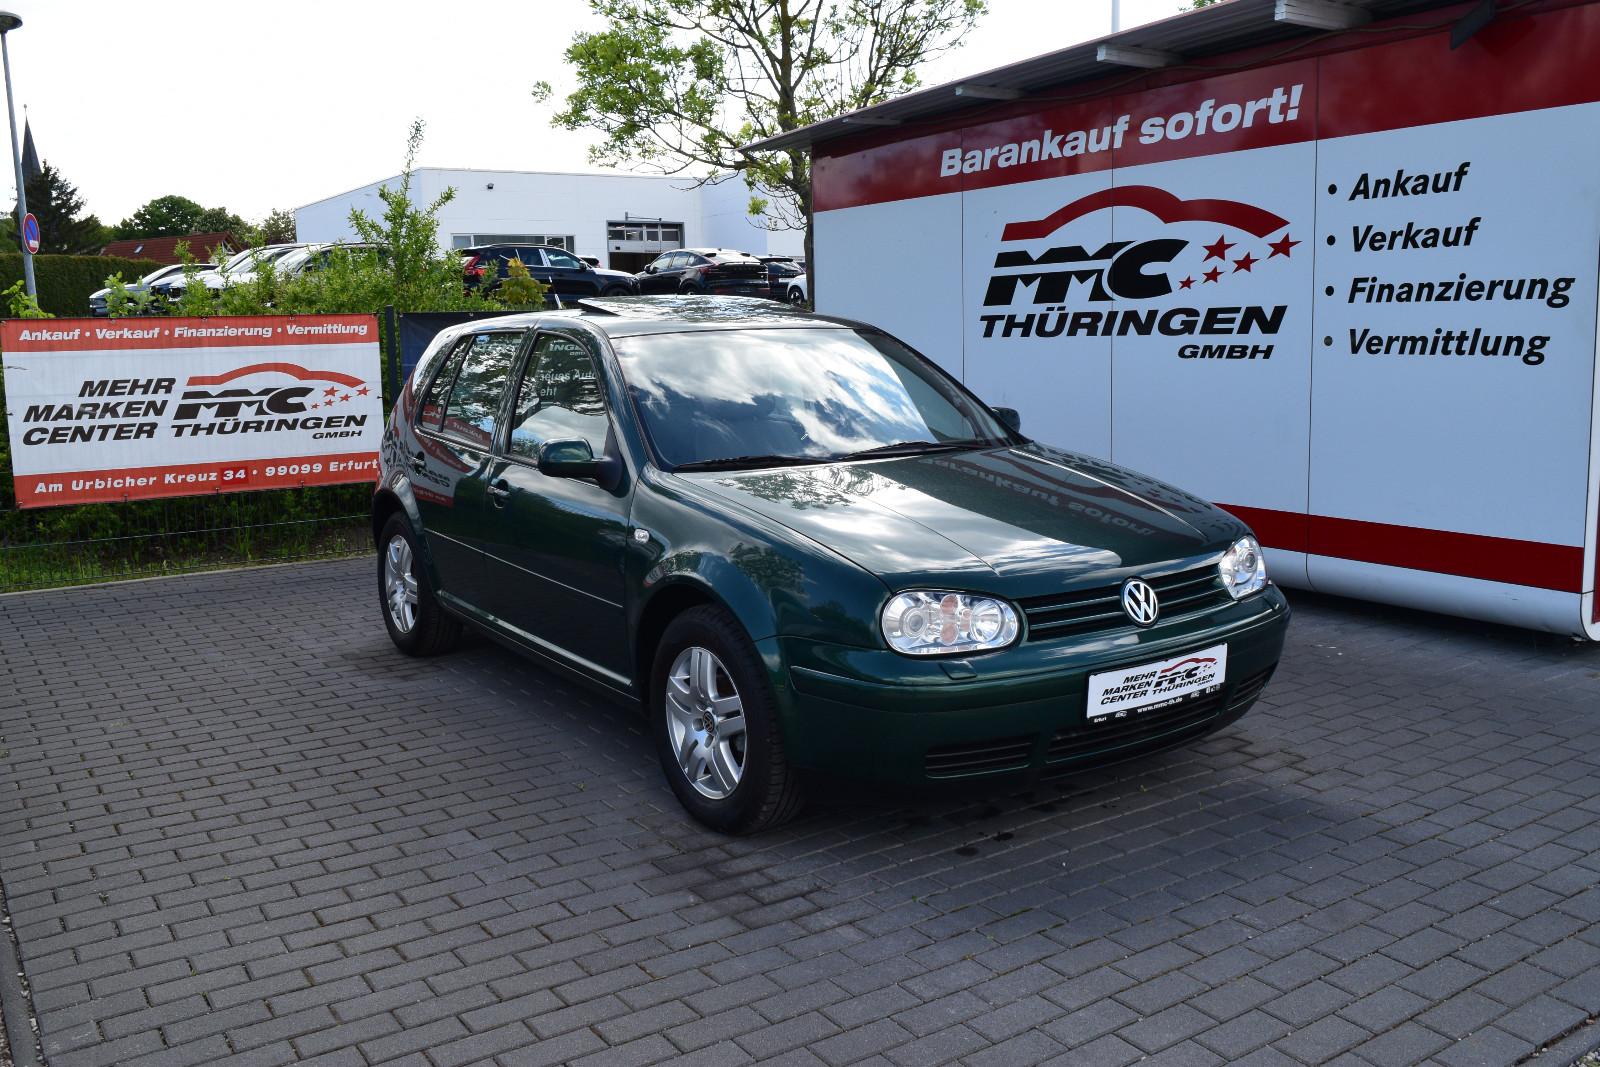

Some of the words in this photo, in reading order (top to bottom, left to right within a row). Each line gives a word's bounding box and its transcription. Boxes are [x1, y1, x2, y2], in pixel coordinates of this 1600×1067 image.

[939, 114, 1130, 178] Barankauf
[1138, 84, 1304, 145] sofort!
[1348, 162, 1471, 201] Ankauf
[1352, 216, 1482, 252] Verkauf
[1348, 273, 1576, 308] Finanzierung
[19, 328, 81, 341] Ankauf
[96, 327, 161, 340] Verkauf
[174, 325, 273, 340] Finanzierung
[286, 323, 368, 336] Vermittlung
[979, 305, 1288, 338] THÜRINGEN
[1177, 344, 1274, 360] GMBH
[1349, 327, 1551, 366] Vermittlung
[78, 377, 176, 398] MEHR
[23, 400, 168, 423] MARKEN
[22, 422, 158, 446] CENTER
[170, 414, 368, 438] THÜRINGEN
[311, 430, 363, 440] GMBH
[34, 480, 63, 494] Am
[71, 474, 157, 492] Urbicher
[164, 471, 218, 484] Kreuz
[222, 468, 246, 481] 34
[265, 463, 323, 477] 99099
[329, 458, 379, 473] Erfurt
[1101, 690, 1149, 705] CENTER
[1153, 673, 1216, 695] THÜRINGEN
[1102, 680, 1153, 696] MARKEN
[1123, 671, 1157, 684] MEHR
